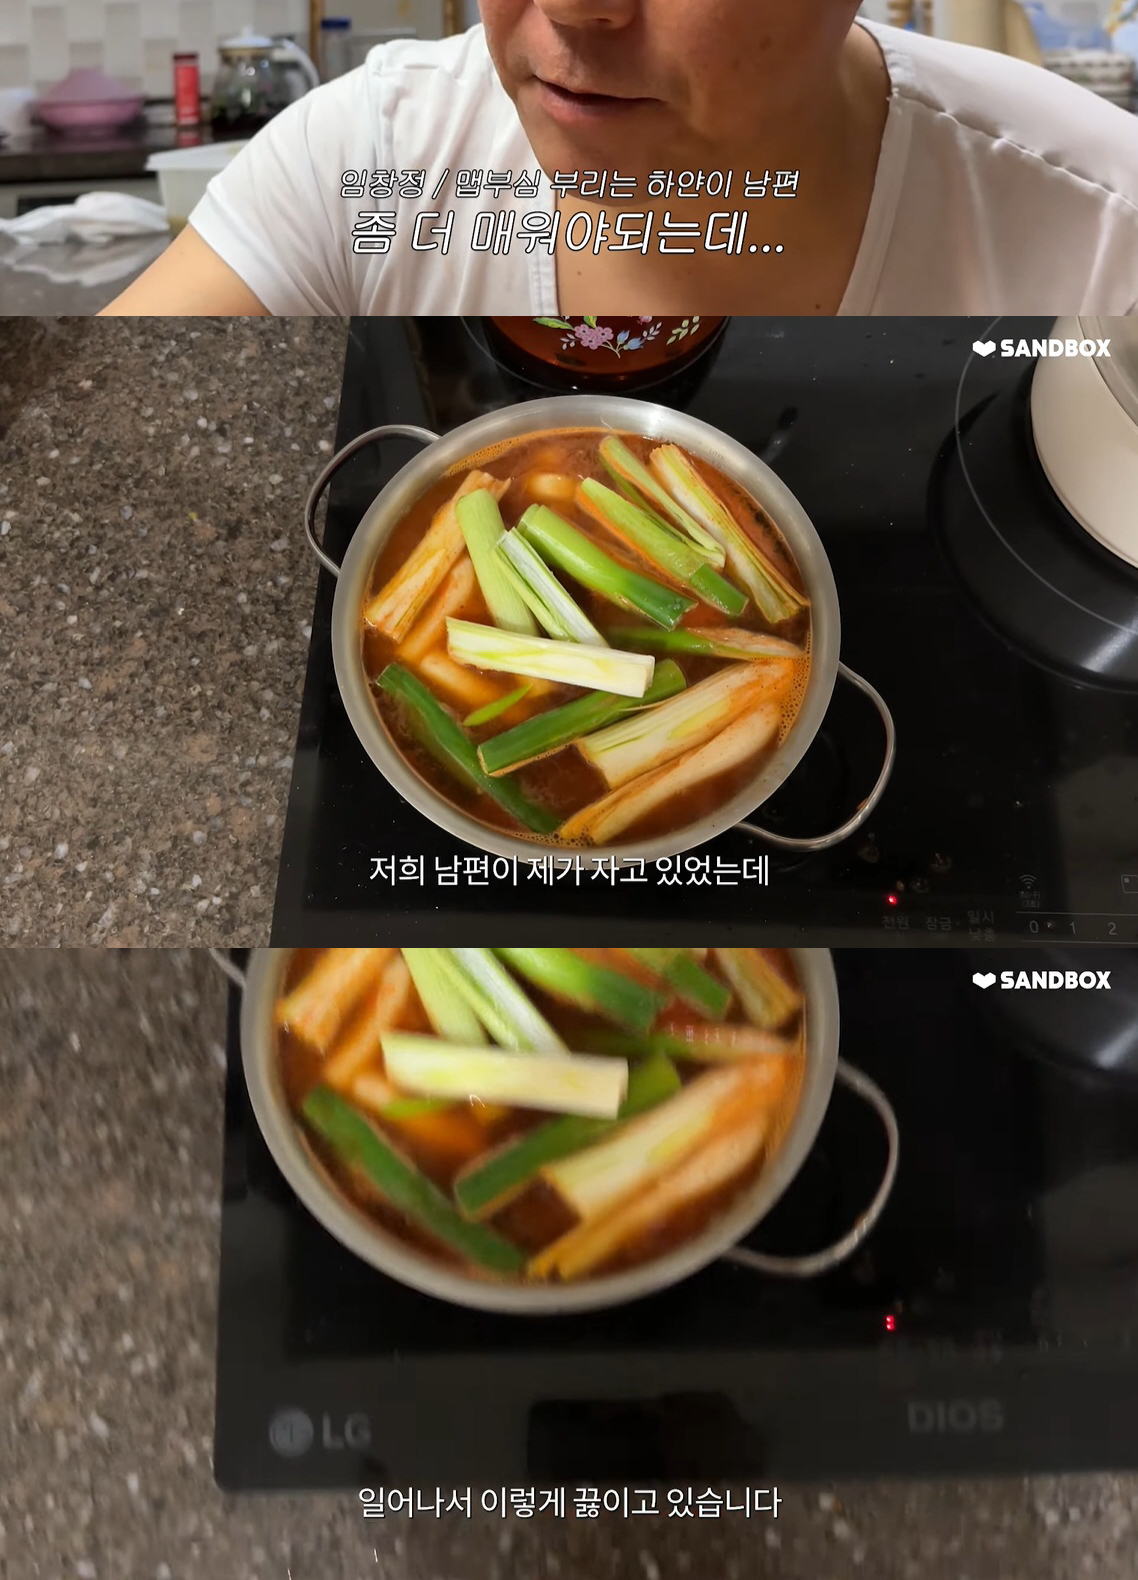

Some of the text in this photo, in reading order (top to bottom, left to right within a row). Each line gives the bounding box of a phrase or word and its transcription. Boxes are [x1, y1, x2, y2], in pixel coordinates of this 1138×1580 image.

[882, 915, 952, 931] 전원 잠금
[967, 910, 995, 925] 일시
[1029, 921, 1117, 935] 0 1 2
[907, 1398, 1004, 1433] DIOS
[322, 1410, 372, 1449] LG
